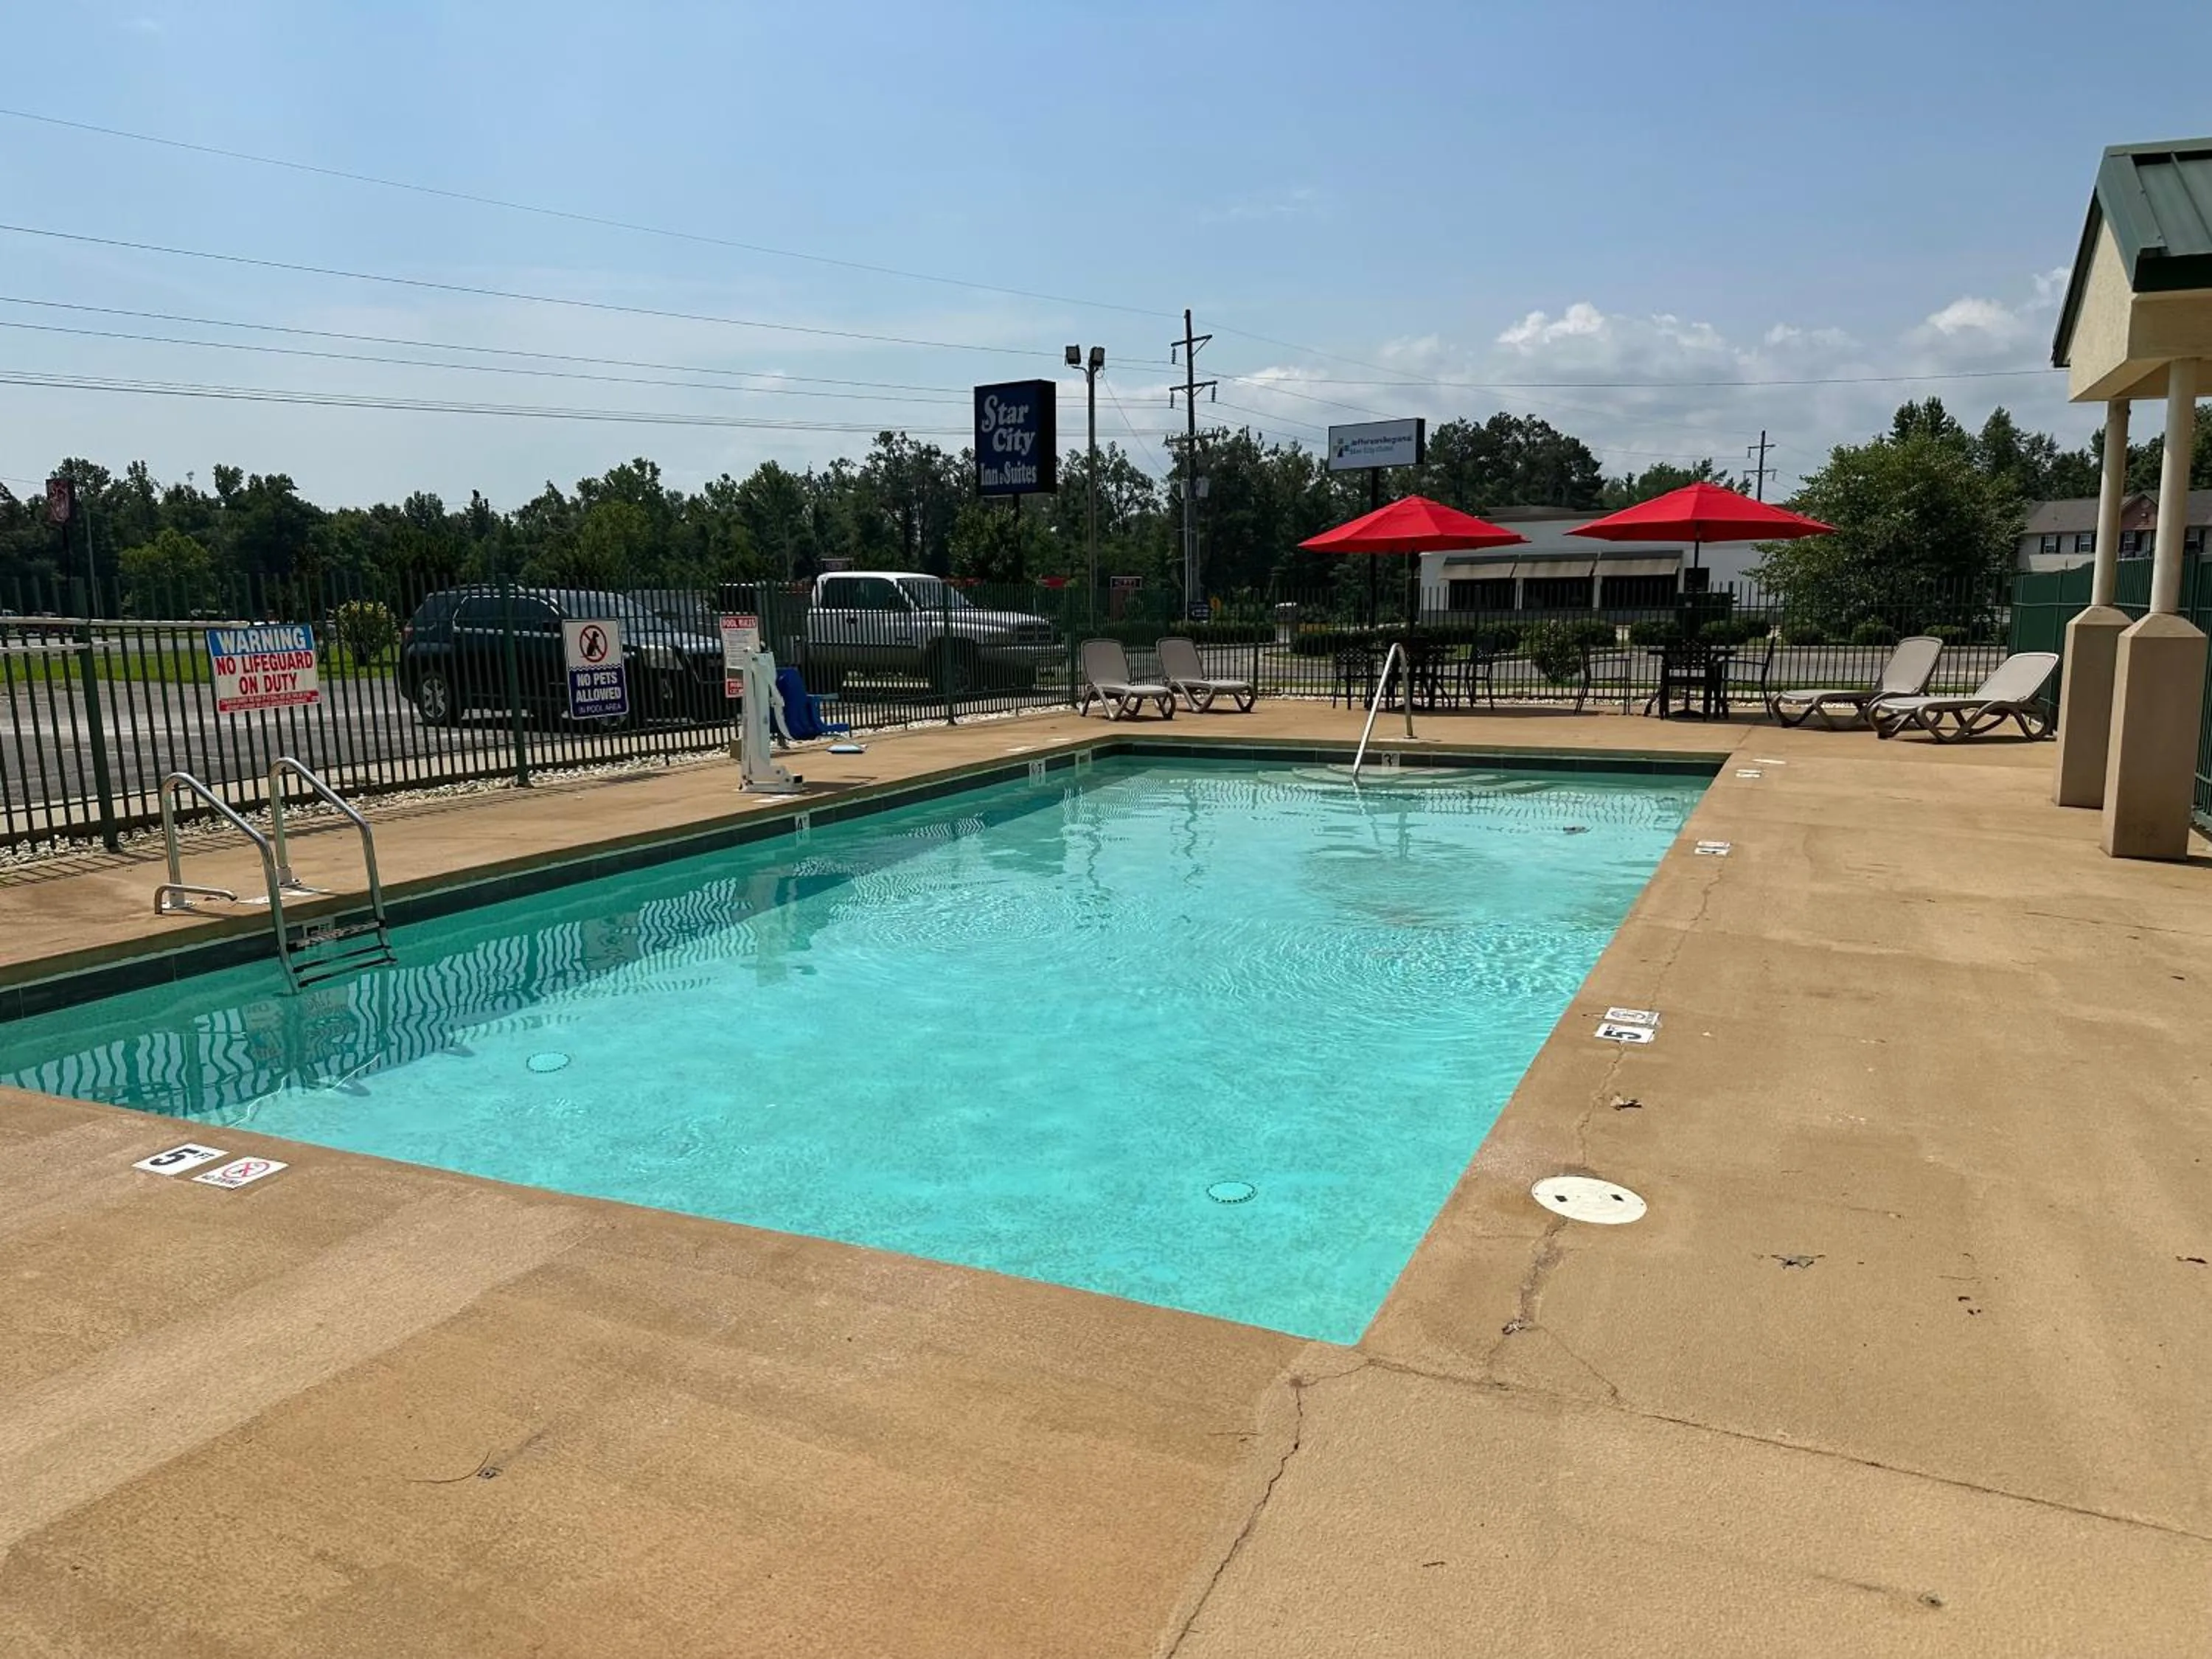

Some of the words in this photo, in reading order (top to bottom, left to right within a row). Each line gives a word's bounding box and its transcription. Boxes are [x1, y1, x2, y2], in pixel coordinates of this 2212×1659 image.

[981, 394, 1029, 432] Star
[992, 427, 1035, 456] City
[981, 462, 998, 486] Inn
[1004, 460, 1037, 484] Suites
[217, 627, 307, 653] WARNING
[215, 657, 237, 675] NO
[241, 652, 313, 674] LIFEGUARD
[239, 676, 258, 695] ON
[264, 672, 298, 692] DUTY
[577, 672, 591, 686] NO
[594, 670, 618, 685] PETS
[576, 686, 622, 703] ALLOWED
[1603, 1029, 1642, 1040] 5
[150, 1148, 200, 1166] 5
